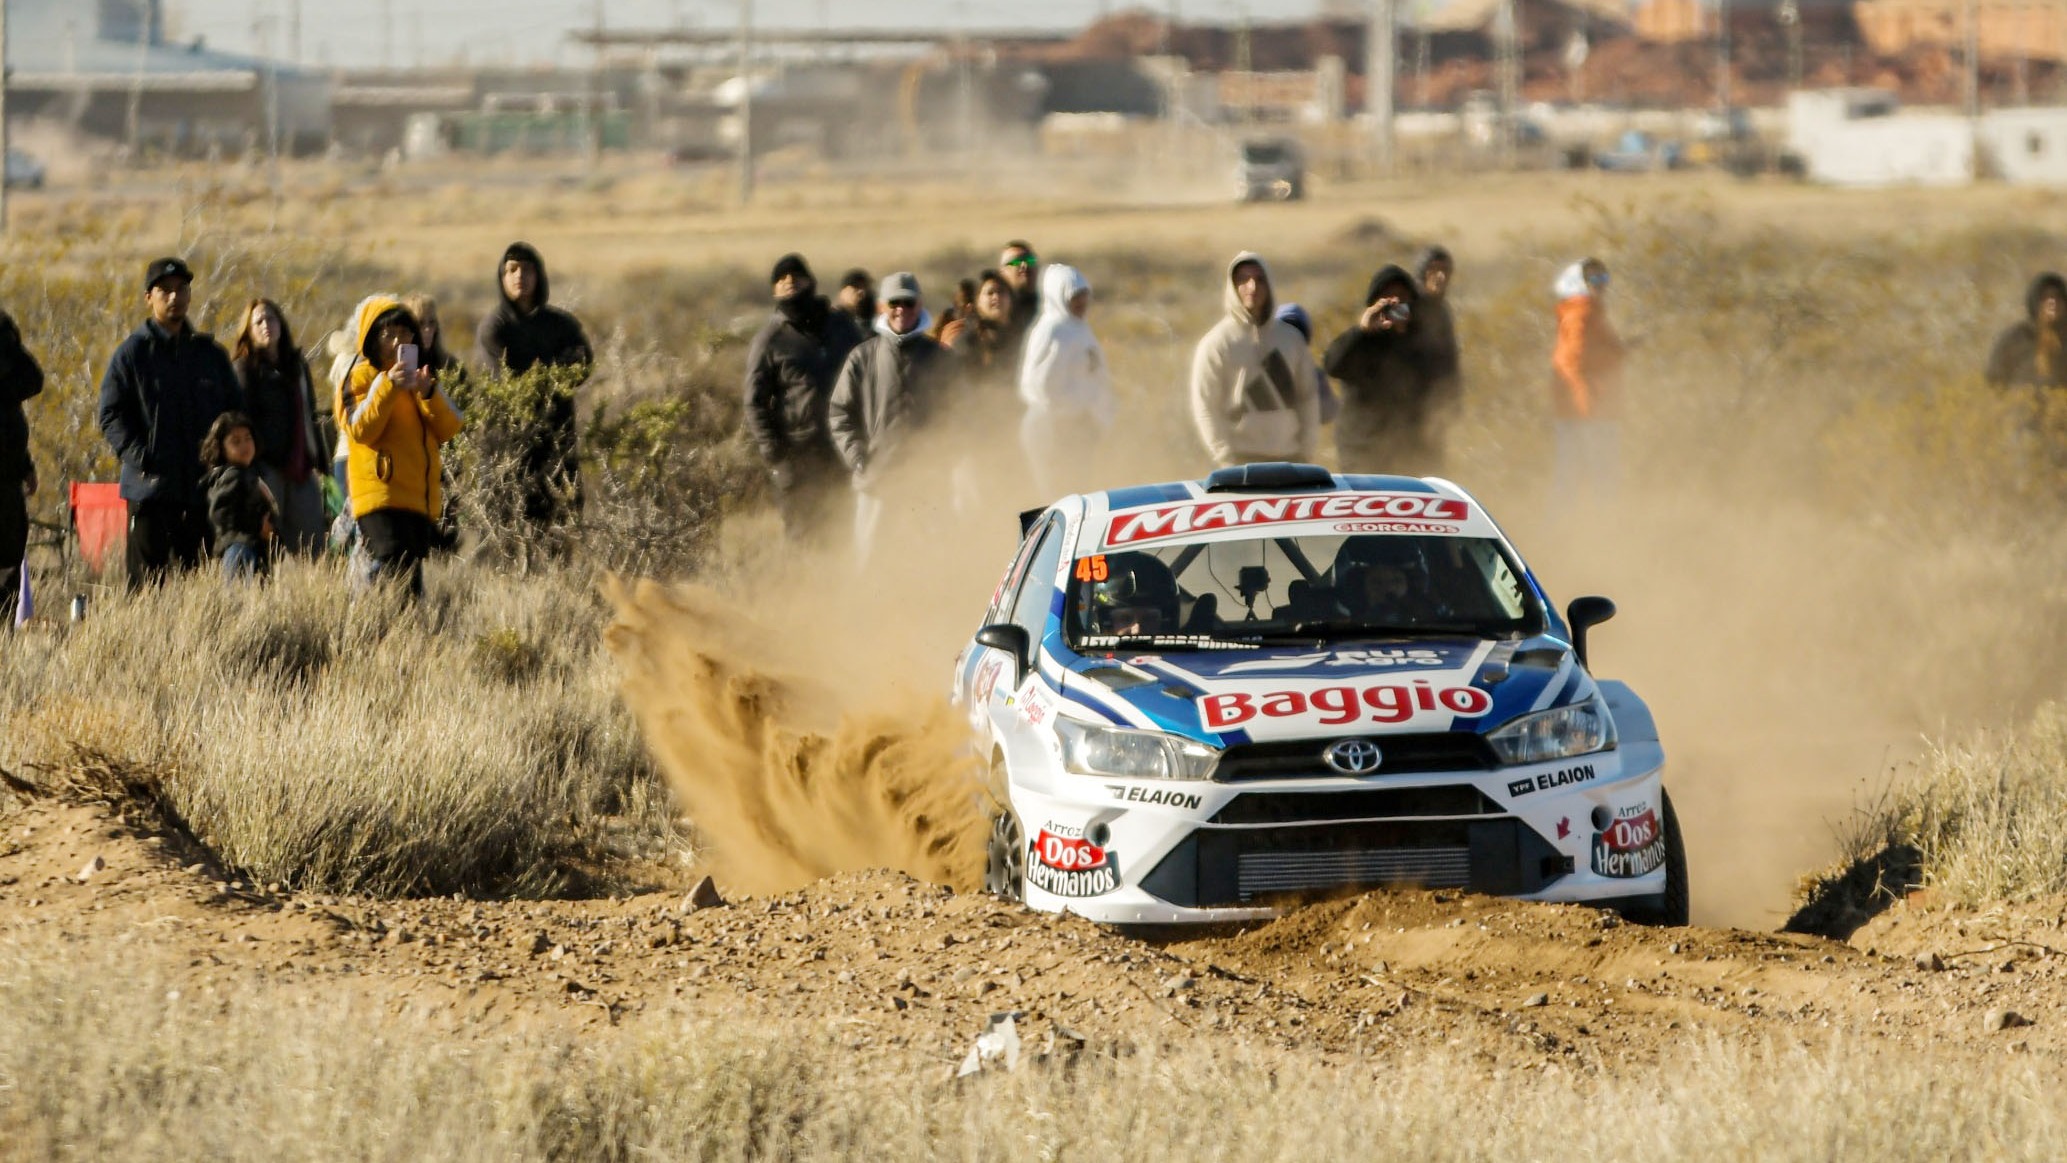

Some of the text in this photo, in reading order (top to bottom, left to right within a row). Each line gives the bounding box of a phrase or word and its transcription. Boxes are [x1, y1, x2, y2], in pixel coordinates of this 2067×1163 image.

[1114, 497, 1455, 541] MANTECOL
[1335, 523, 1459, 533] GEORGALOS
[1075, 556, 1109, 582] 45
[1203, 680, 1491, 725] Baggio
[1537, 765, 1595, 790] ELAION
[1127, 787, 1202, 809] ELAION
[1044, 820, 1082, 837] Arroz
[1615, 820, 1652, 847] Dos
[1044, 837, 1093, 866] Dos
[1027, 850, 1115, 896] Hermanos
